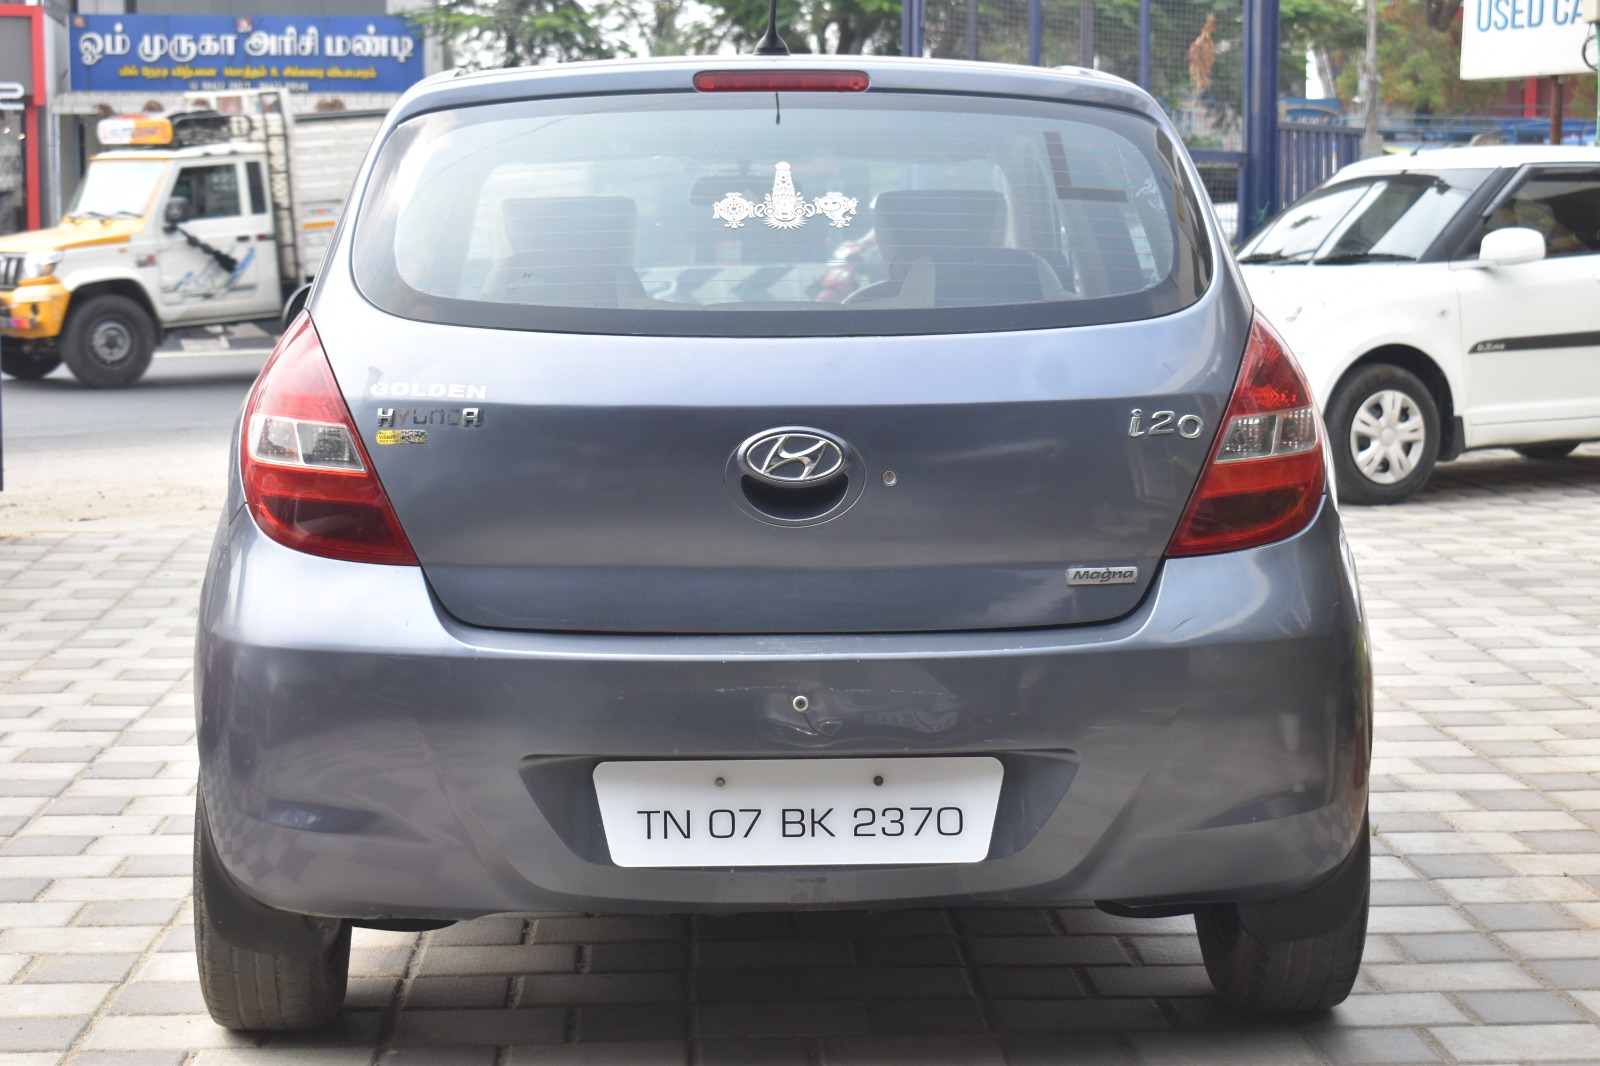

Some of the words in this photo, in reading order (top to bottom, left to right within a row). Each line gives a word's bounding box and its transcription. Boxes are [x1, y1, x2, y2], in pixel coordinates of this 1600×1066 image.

[1476, 0, 1544, 32] USED
[79, 22, 131, 66] ஓம்
[138, 33, 238, 62] முருகா
[244, 25, 319, 57] அரிசி
[324, 24, 414, 63] மண்டி
[370, 382, 487, 399] GOLDEN
[1129, 408, 1204, 439] i20
[1073, 568, 1134, 583] Magna
[637, 809, 691, 840] TN
[708, 808, 762, 839] 07
[781, 807, 837, 838] BK
[853, 806, 965, 838] 2370
